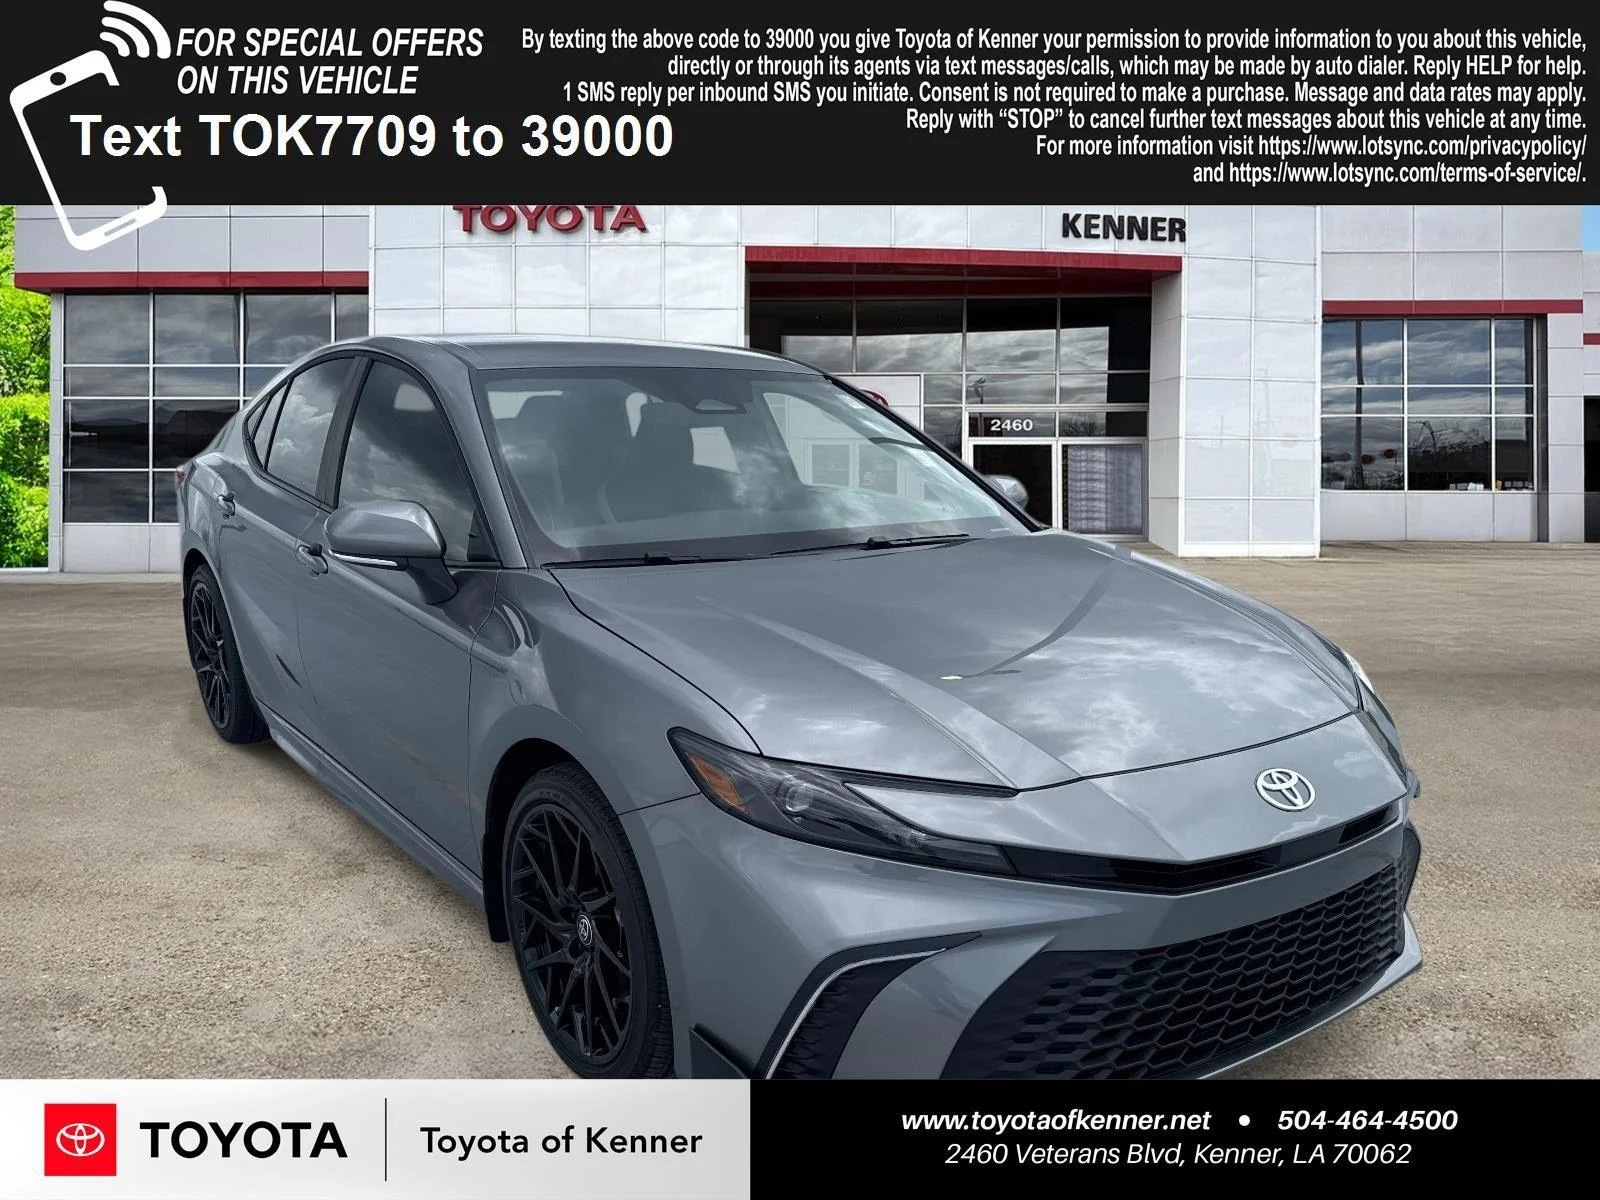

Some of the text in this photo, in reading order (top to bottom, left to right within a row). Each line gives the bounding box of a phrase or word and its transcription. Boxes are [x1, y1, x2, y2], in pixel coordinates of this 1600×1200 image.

[453, 205, 647, 233] TOYOTA
[1062, 213, 1187, 242] KENNER
[990, 419, 1033, 431] 2460
